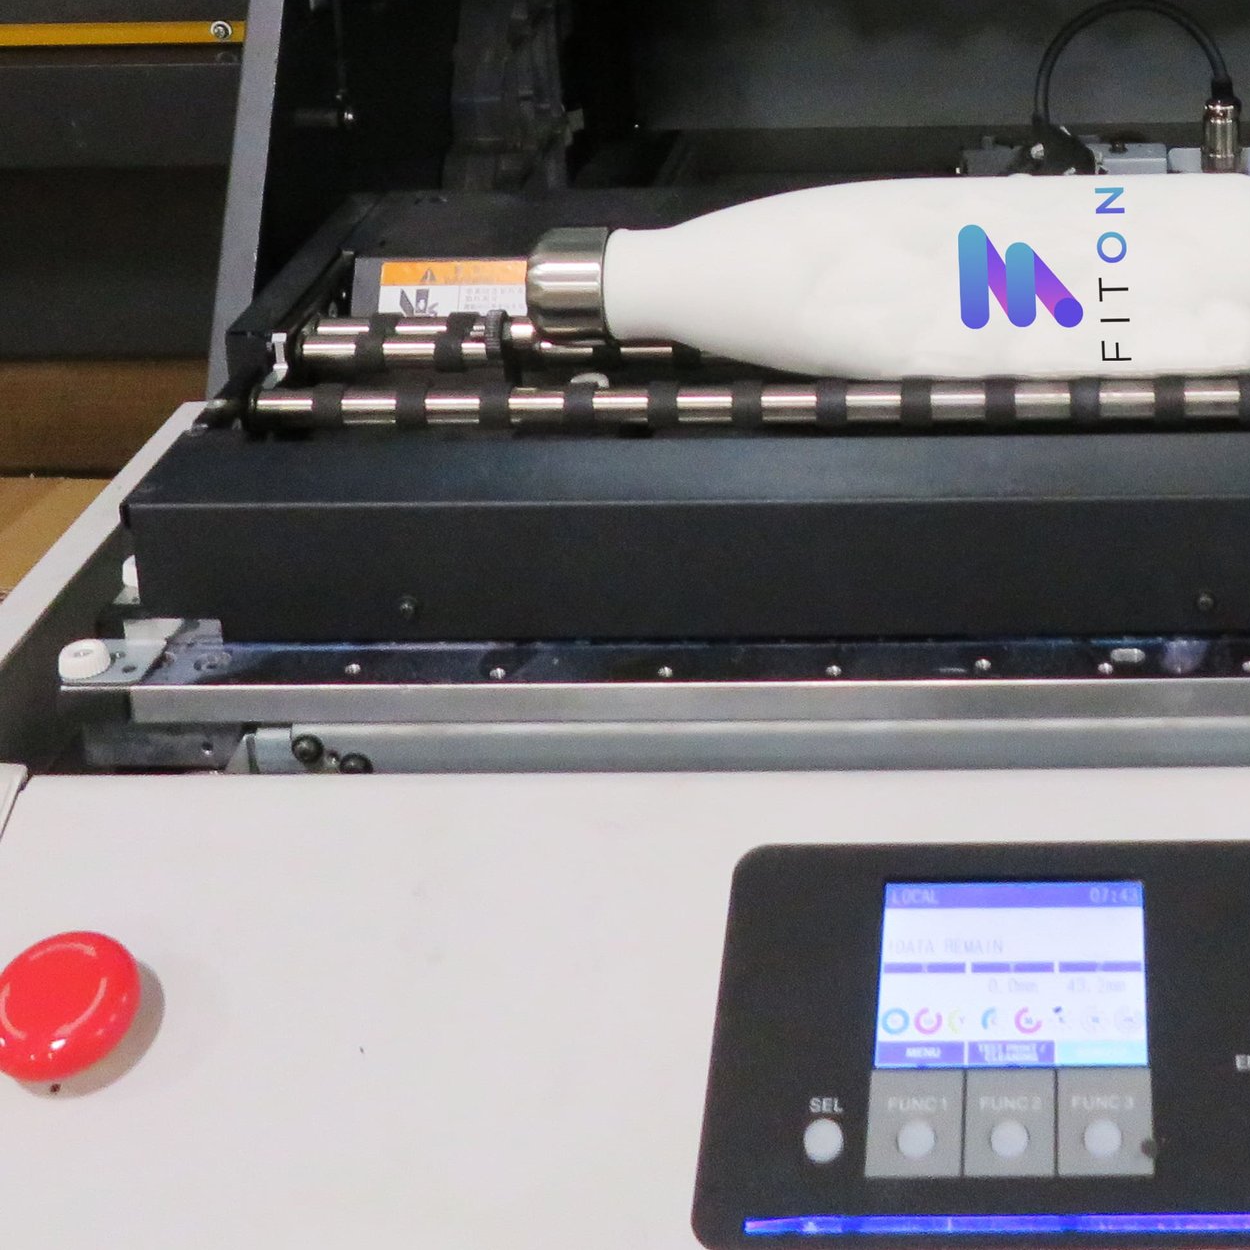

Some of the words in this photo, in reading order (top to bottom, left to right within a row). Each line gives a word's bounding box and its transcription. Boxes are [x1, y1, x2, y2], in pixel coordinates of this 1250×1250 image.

[1095, 187, 1132, 361] FITON
[891, 888, 939, 904] LOCAL
[944, 938, 1004, 955] REMAIN
[905, 1047, 942, 1059] MENU
[809, 1097, 844, 1113] SEL
[887, 1097, 938, 1112] FUNC
[979, 1097, 1029, 1111] FUNC
[1032, 1097, 1043, 1111] 2
[1071, 1096, 1121, 1110] FUNC
[1123, 1095, 1135, 1110] 3
